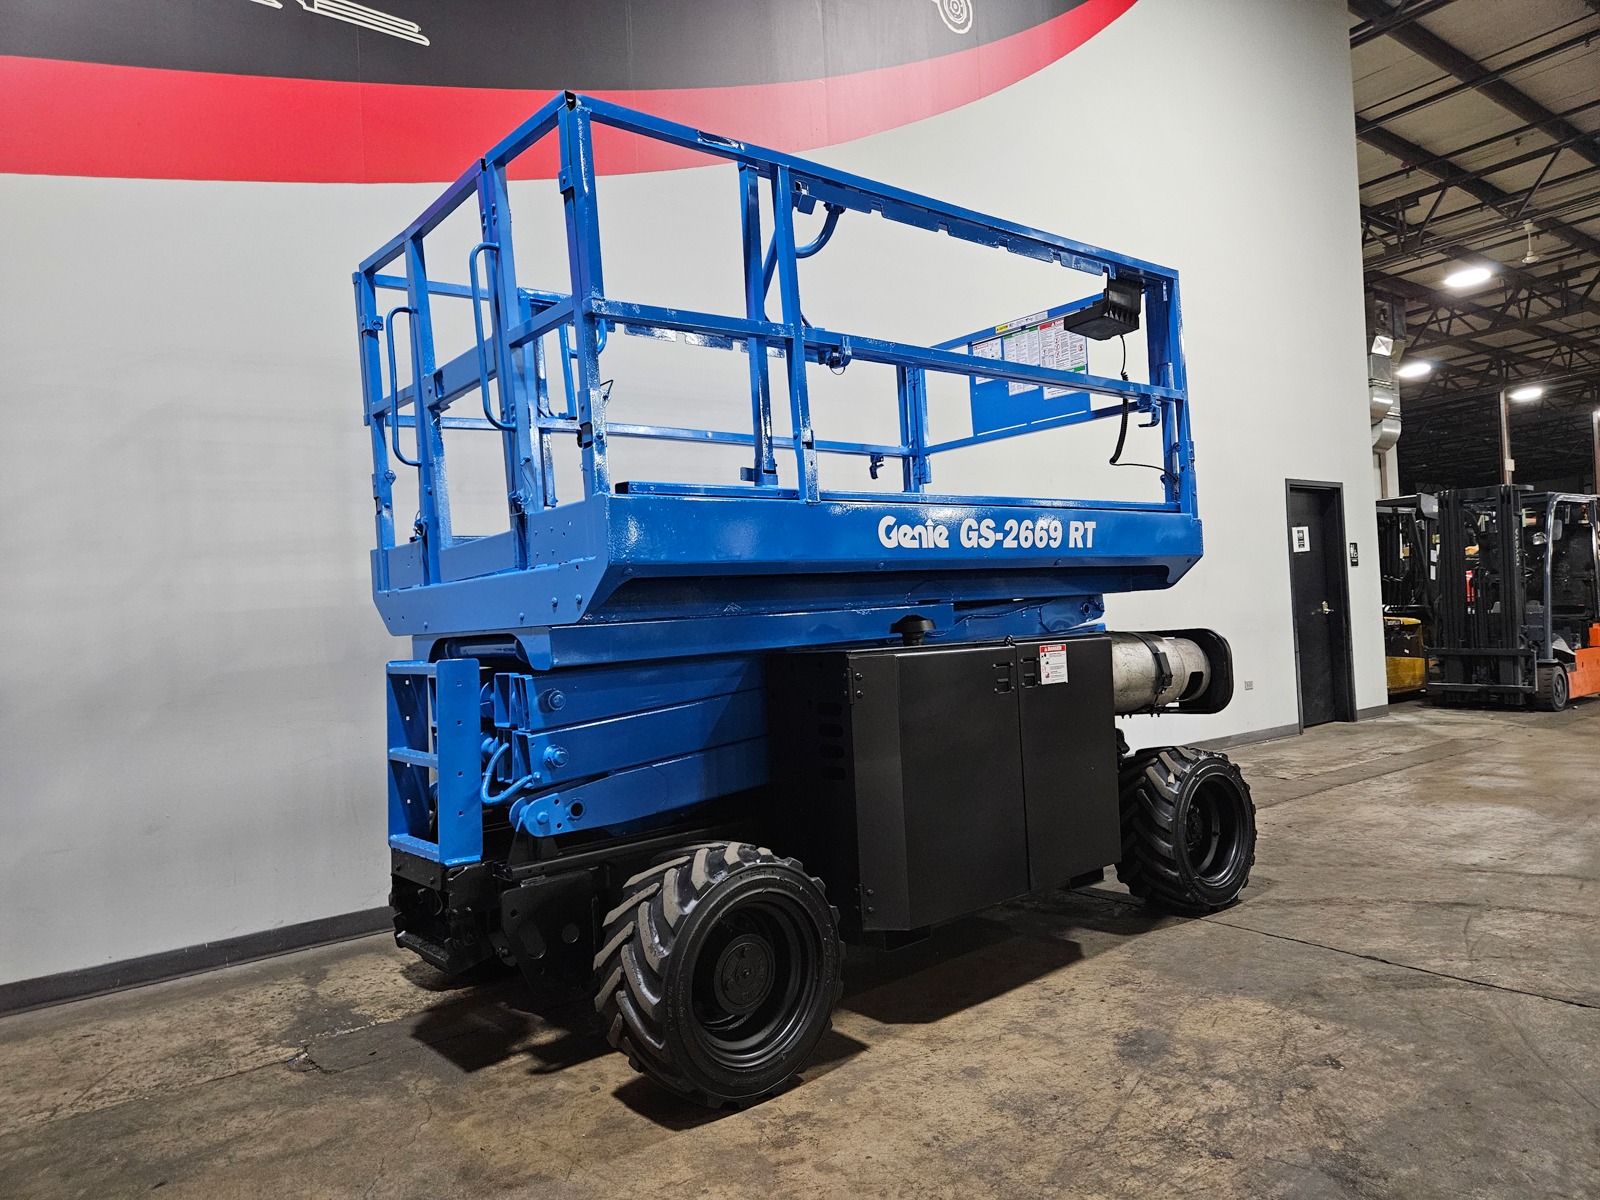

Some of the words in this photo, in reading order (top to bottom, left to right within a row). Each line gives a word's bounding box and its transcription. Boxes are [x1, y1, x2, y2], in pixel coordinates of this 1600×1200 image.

[878, 515, 949, 548] Genie
[960, 518, 1062, 548] GS-2669
[1069, 521, 1096, 548] RT
